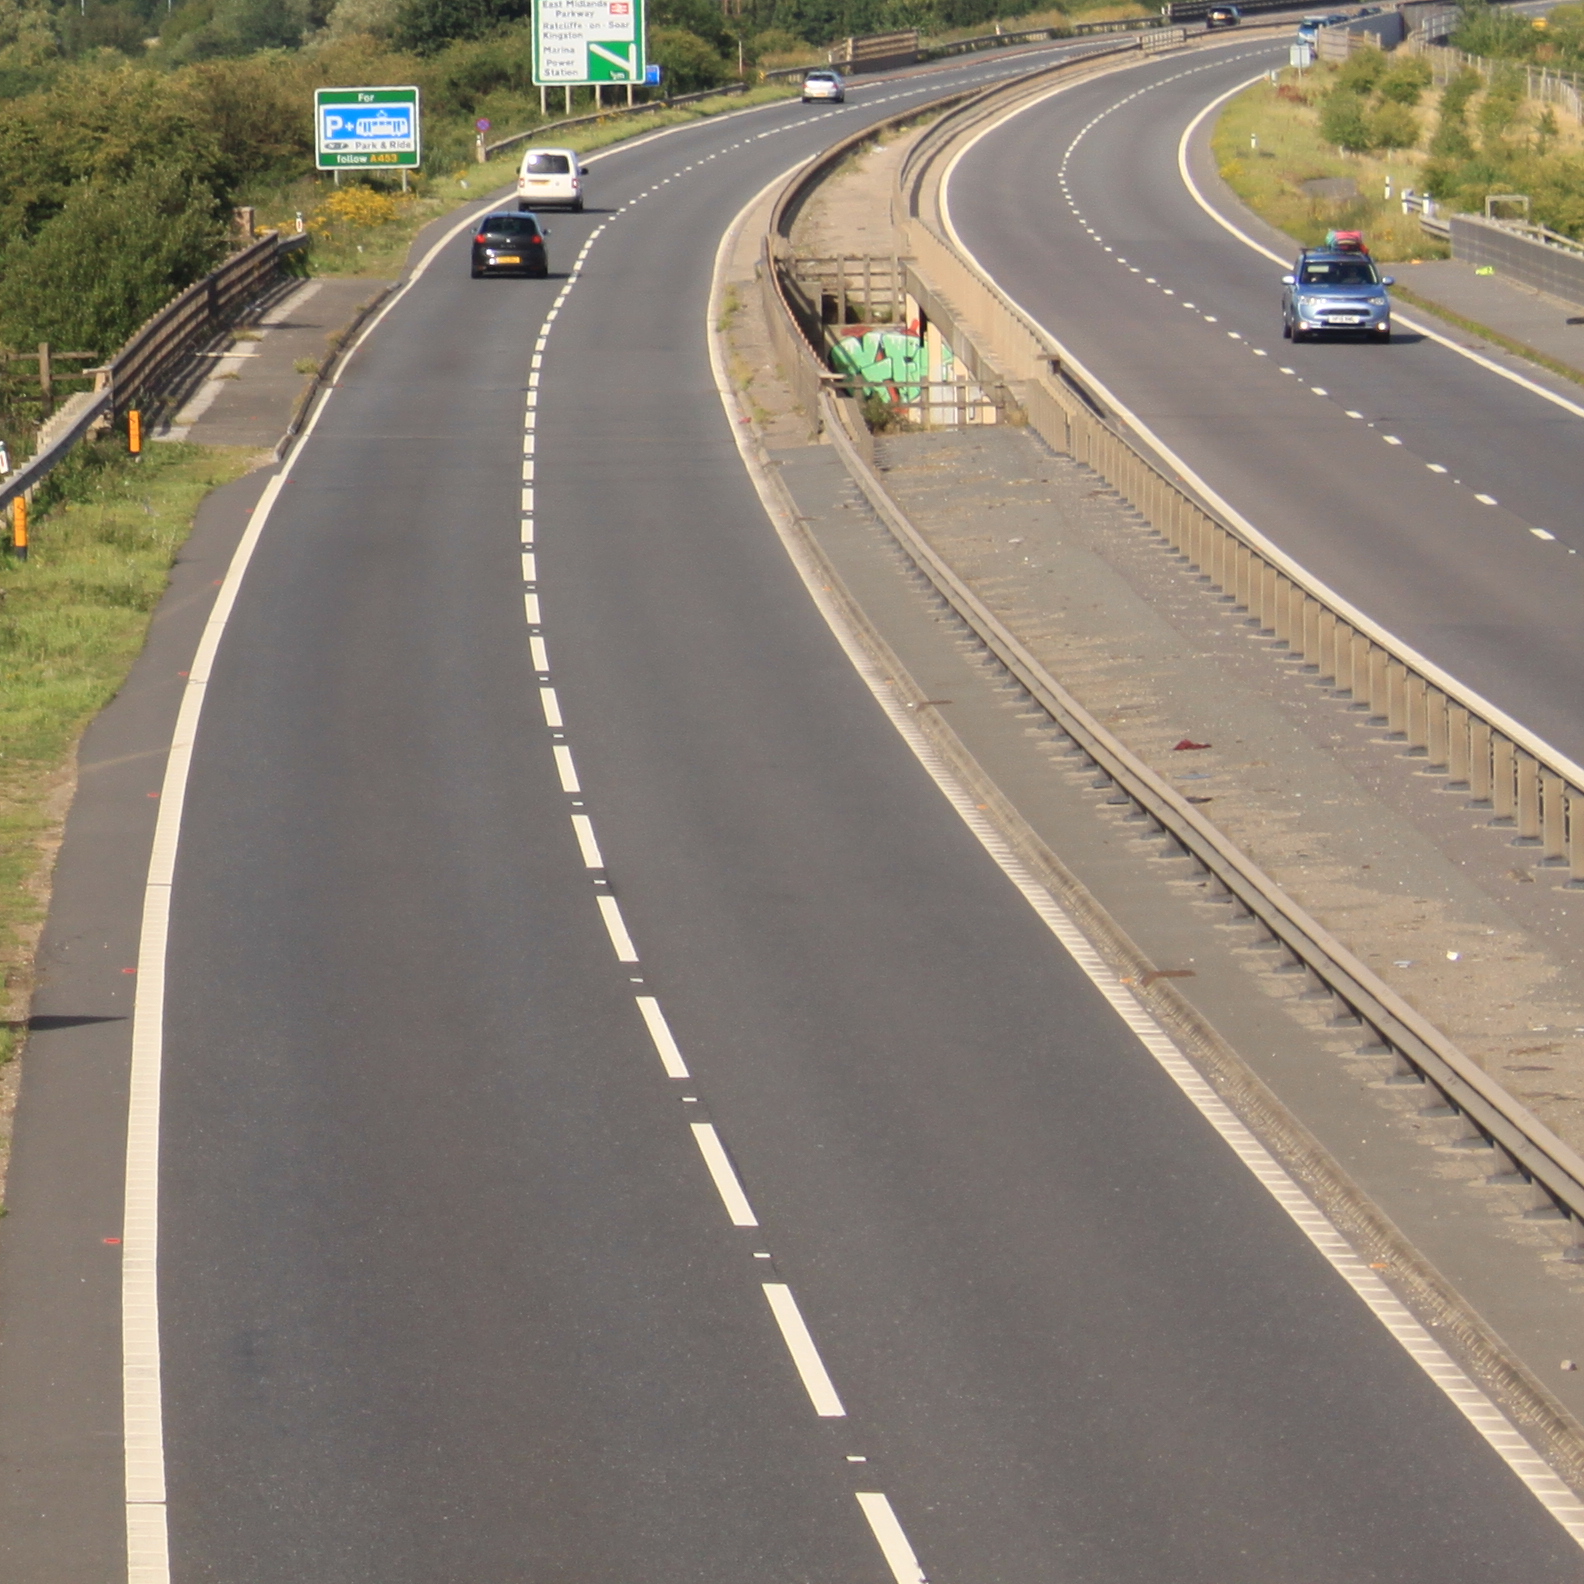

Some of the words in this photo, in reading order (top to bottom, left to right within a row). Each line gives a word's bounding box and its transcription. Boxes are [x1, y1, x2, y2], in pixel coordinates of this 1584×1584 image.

[542, 0, 562, 8] East
[566, 0, 608, 8] Midlands
[555, 10, 595, 18] Parkway
[543, 33, 583, 41] Kingston
[543, 46, 575, 54] Marina
[544, 68, 579, 76] Station
[357, 93, 375, 102] For
[355, 141, 377, 149] Park
[380, 141, 387, 149] &
[389, 140, 411, 148] Ride
[336, 154, 367, 164] follow
[370, 153, 398, 163] A453
